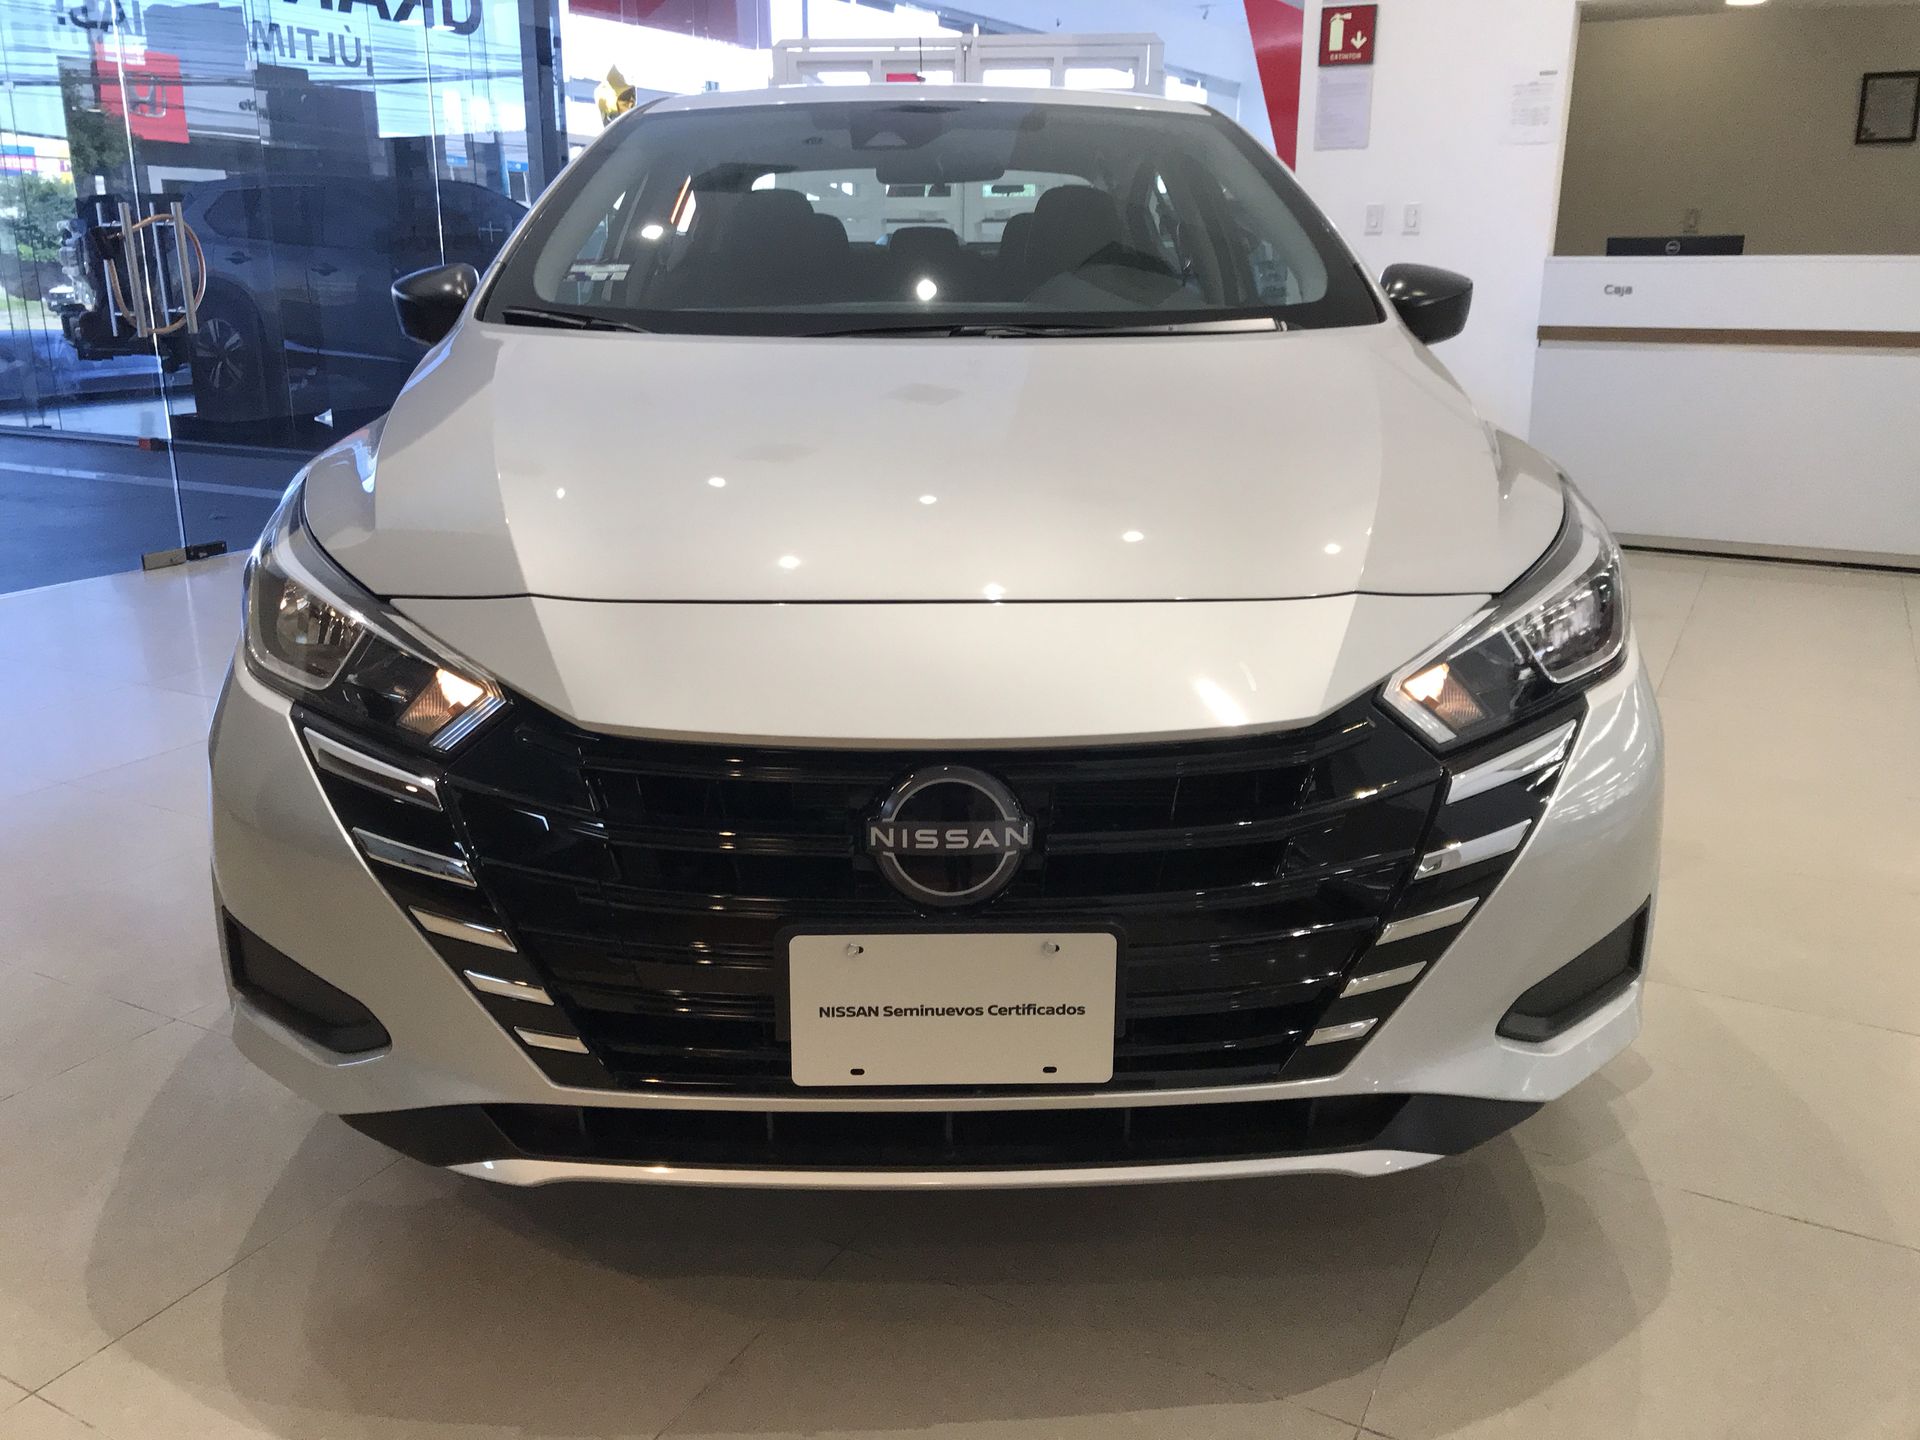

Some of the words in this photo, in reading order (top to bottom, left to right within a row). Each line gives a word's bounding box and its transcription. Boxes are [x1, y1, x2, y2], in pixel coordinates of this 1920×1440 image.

[1604, 284, 1633, 297] Caja
[870, 826, 1029, 849] NISSAN
[819, 1005, 879, 1018] NISSAN
[883, 1004, 984, 1017] Seminuevos
[987, 1003, 1086, 1016] Certificados
